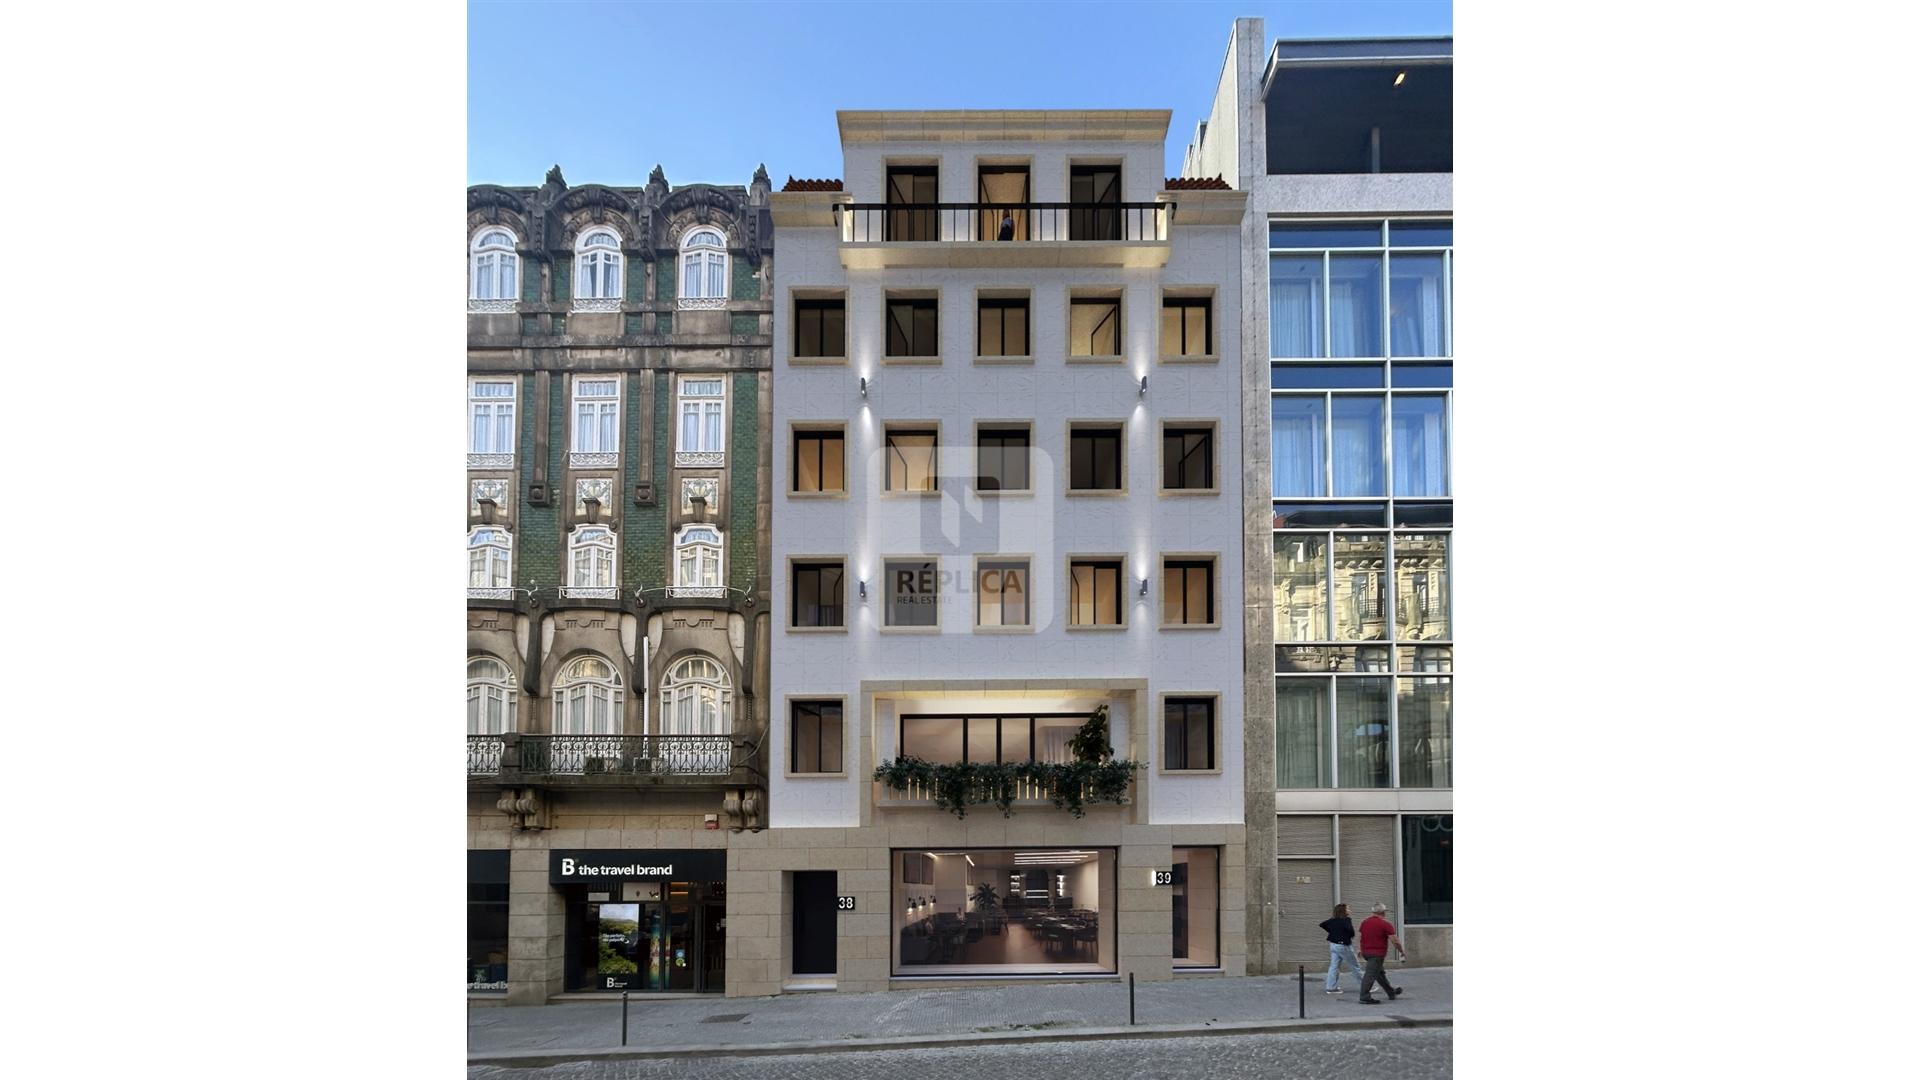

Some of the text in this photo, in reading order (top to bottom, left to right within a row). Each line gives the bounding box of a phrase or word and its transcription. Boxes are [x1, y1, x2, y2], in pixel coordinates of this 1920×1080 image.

[562, 858, 673, 876] B the travel brand
[1157, 872, 1171, 884] 39
[838, 897, 853, 909] 38
